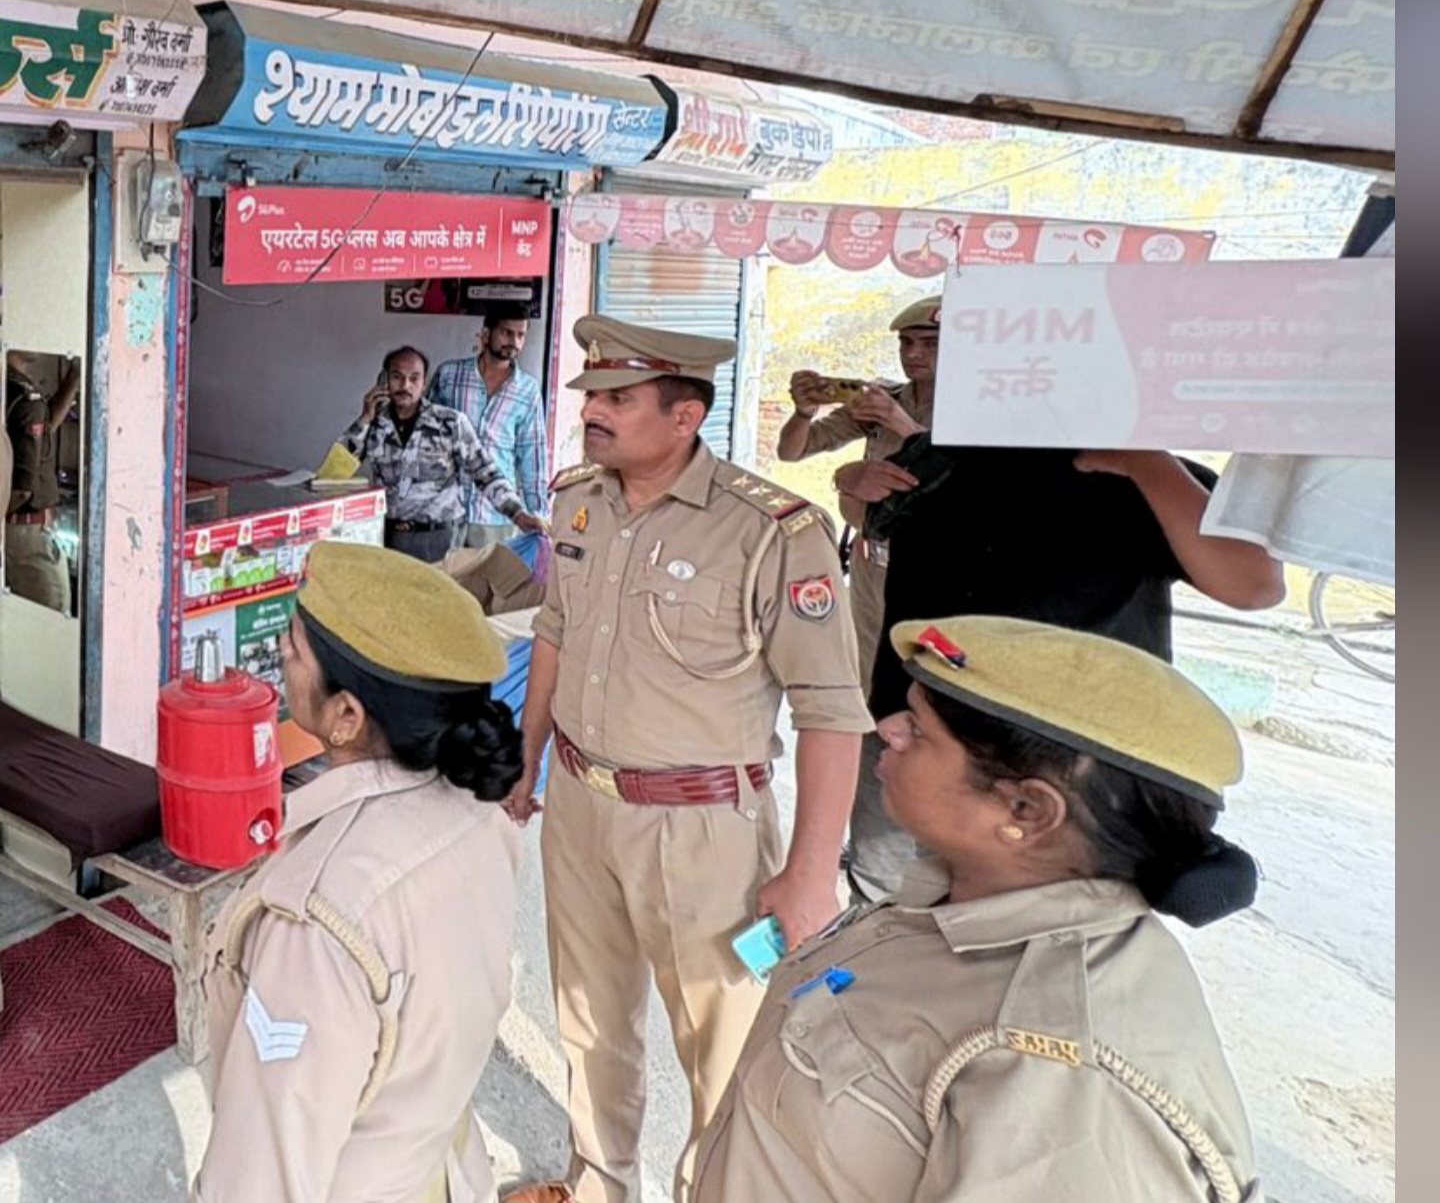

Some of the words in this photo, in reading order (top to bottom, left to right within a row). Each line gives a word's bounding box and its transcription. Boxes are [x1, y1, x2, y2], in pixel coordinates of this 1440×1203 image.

[253, 48, 376, 132] श्याम
[365, 63, 510, 149] मोबाइल
[260, 222, 319, 253] एयरटेल
[382, 228, 406, 248] अब
[410, 224, 451, 250] आपके
[452, 224, 474, 249] क्षेत्र
[474, 224, 488, 248] में
[510, 219, 539, 236] MNP
[389, 286, 425, 310] 5G
